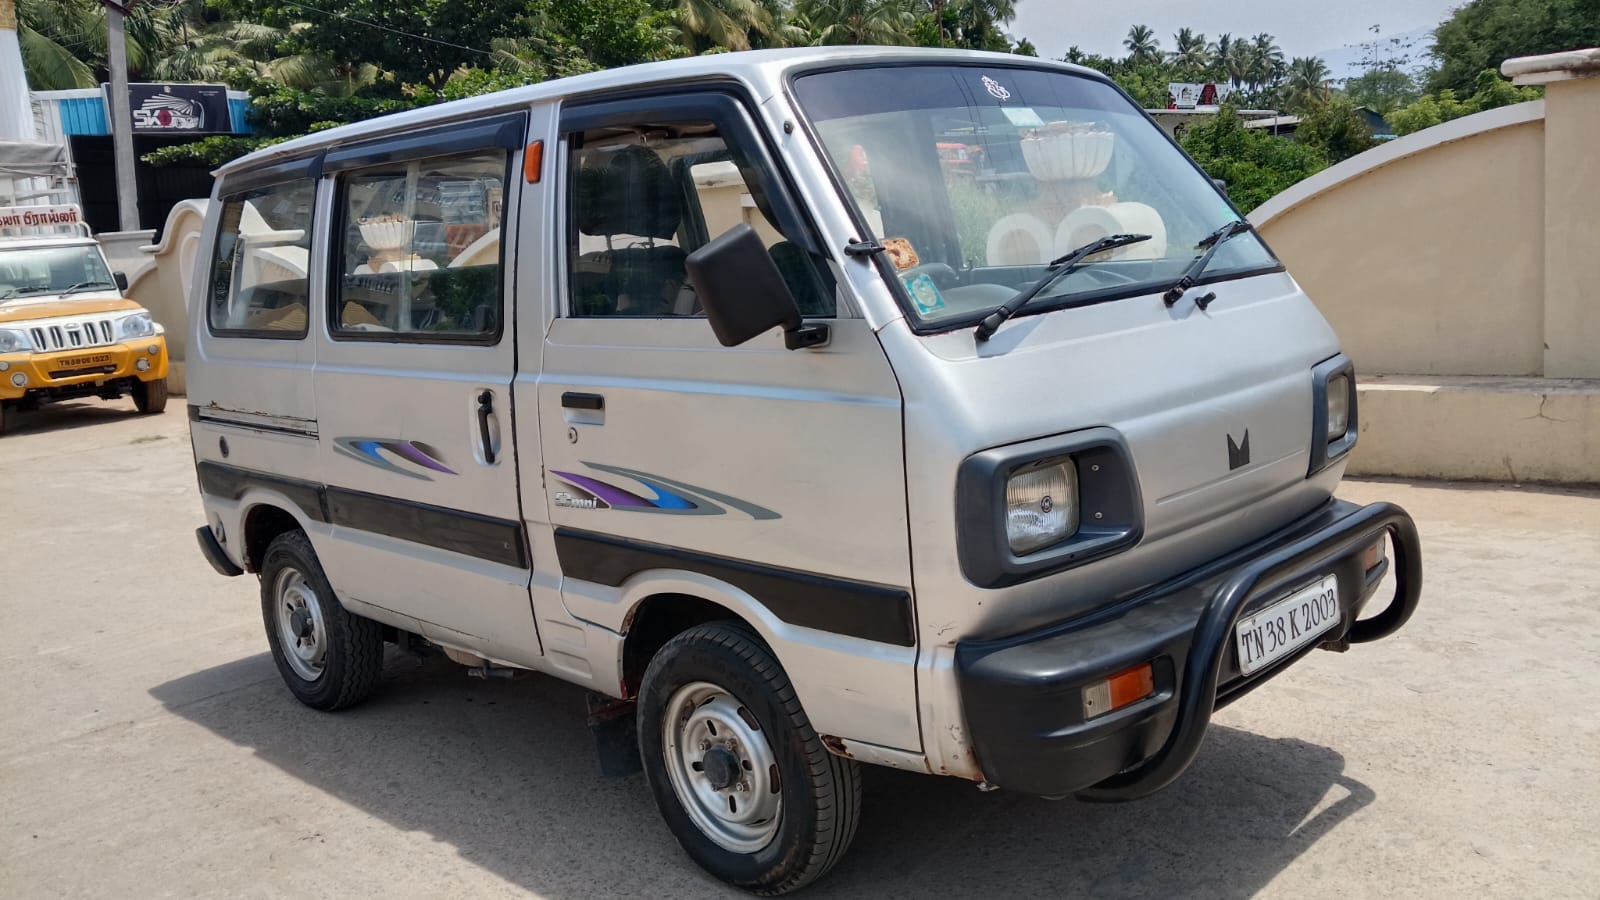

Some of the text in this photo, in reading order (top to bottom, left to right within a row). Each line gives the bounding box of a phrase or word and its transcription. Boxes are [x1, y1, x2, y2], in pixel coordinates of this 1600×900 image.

[1241, 588, 1336, 664] TN 38 K 2003
